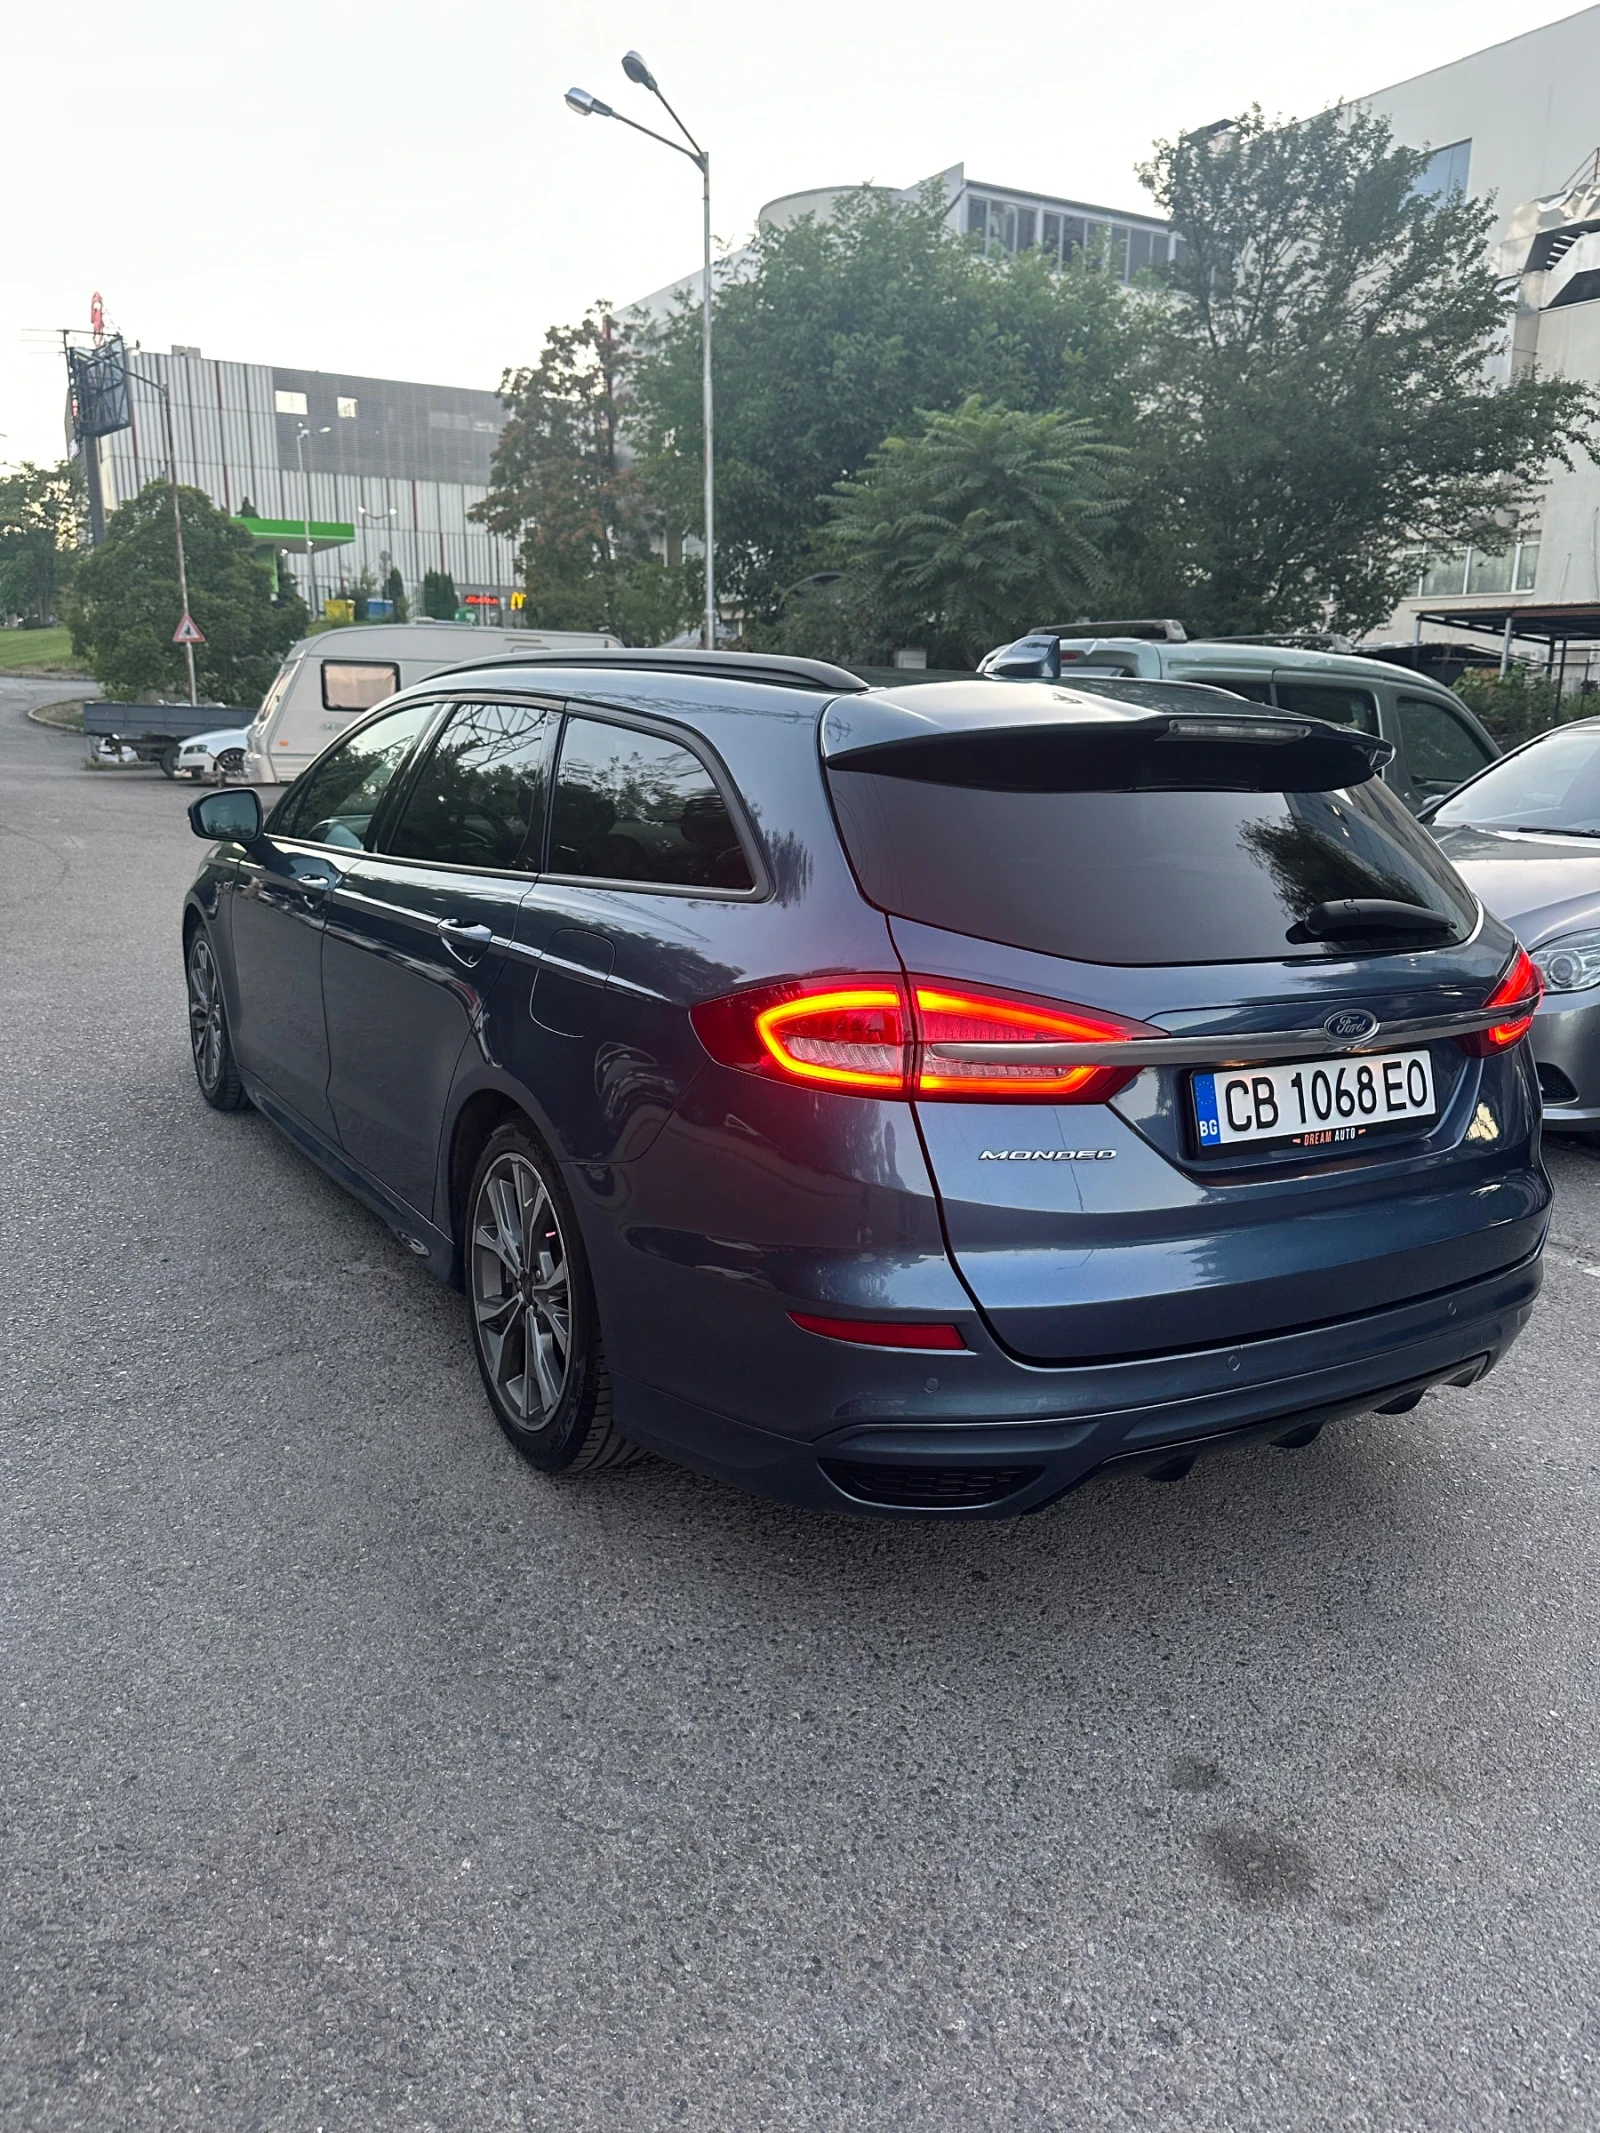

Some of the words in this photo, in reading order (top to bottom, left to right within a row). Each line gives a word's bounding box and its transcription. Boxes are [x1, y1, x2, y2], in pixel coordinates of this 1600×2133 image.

[1336, 1015, 1367, 1035] Ford
[1225, 1076, 1279, 1132] CB
[1291, 1065, 1377, 1125] 1068
[1382, 1058, 1428, 1113] EO
[1200, 1119, 1218, 1137] BG
[1303, 1130, 1332, 1146] DREAM
[1334, 1127, 1356, 1142] AUTO
[978, 1149, 1118, 1162] MONDEO
